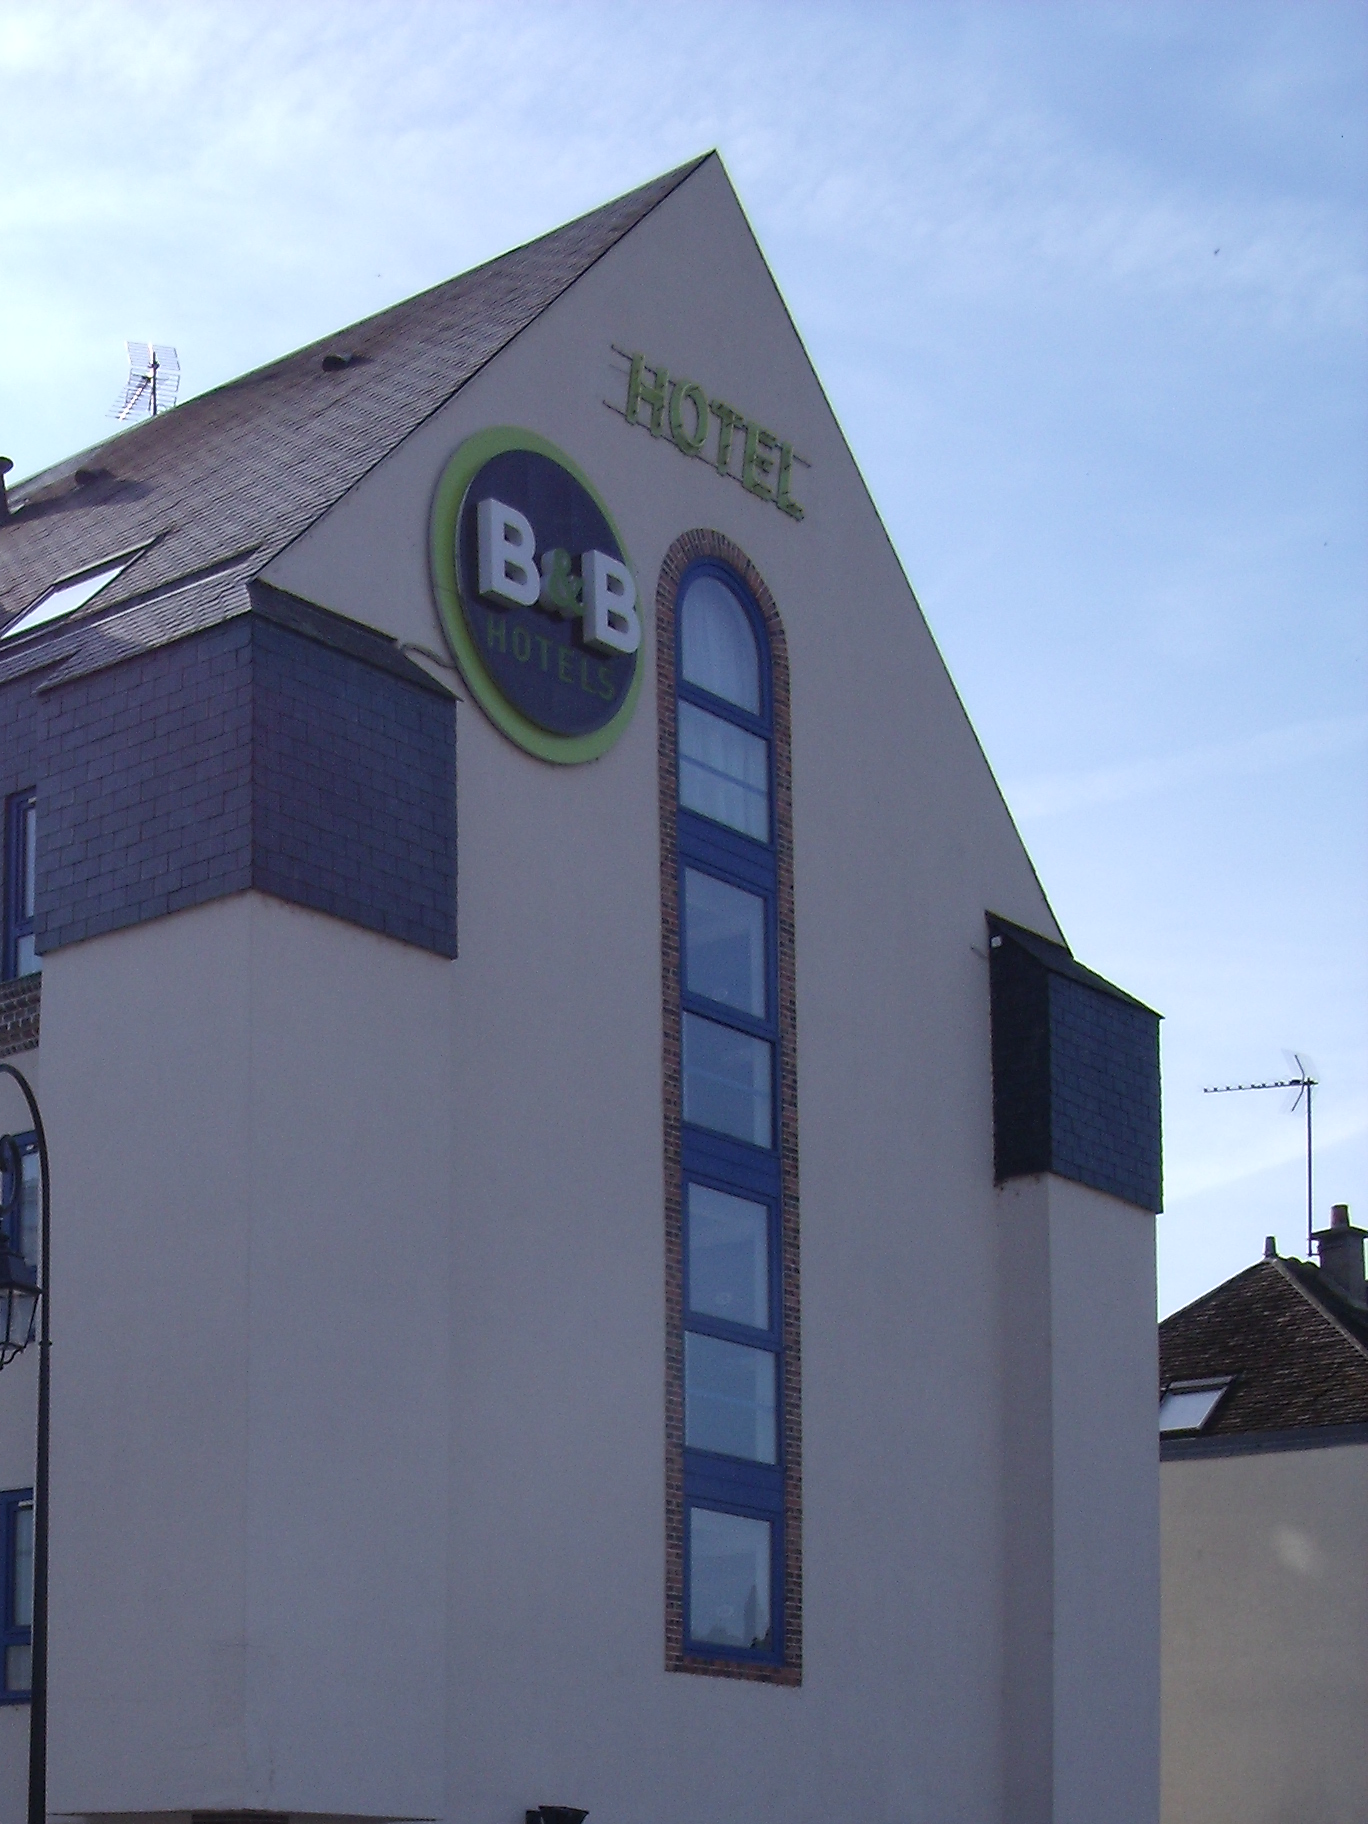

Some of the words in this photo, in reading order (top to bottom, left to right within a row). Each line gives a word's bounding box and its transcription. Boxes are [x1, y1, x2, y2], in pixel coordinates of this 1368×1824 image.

[624, 351, 806, 522] HOTEL
[476, 497, 643, 655] B&B
[484, 613, 618, 702] HOTELS
